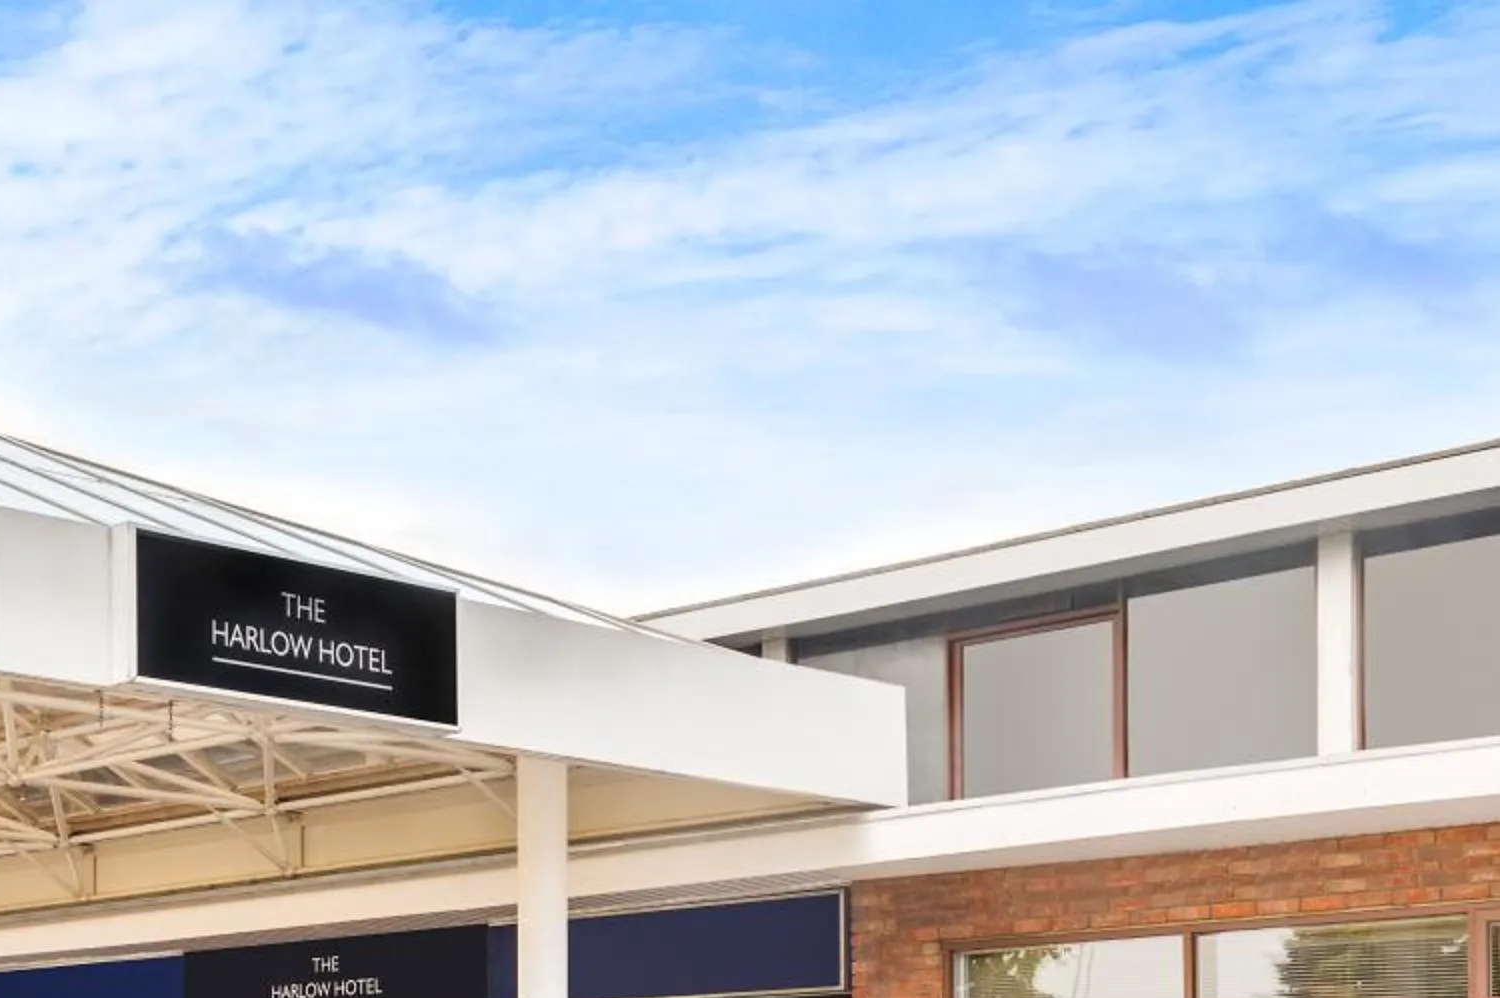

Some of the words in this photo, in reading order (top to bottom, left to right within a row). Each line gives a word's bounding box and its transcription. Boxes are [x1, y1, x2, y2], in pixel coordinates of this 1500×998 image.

[282, 592, 326, 623] THE
[211, 619, 313, 659] HARLOW
[319, 638, 393, 675] HOTEL
[312, 955, 340, 973] THE
[334, 977, 383, 997] HOTEL
